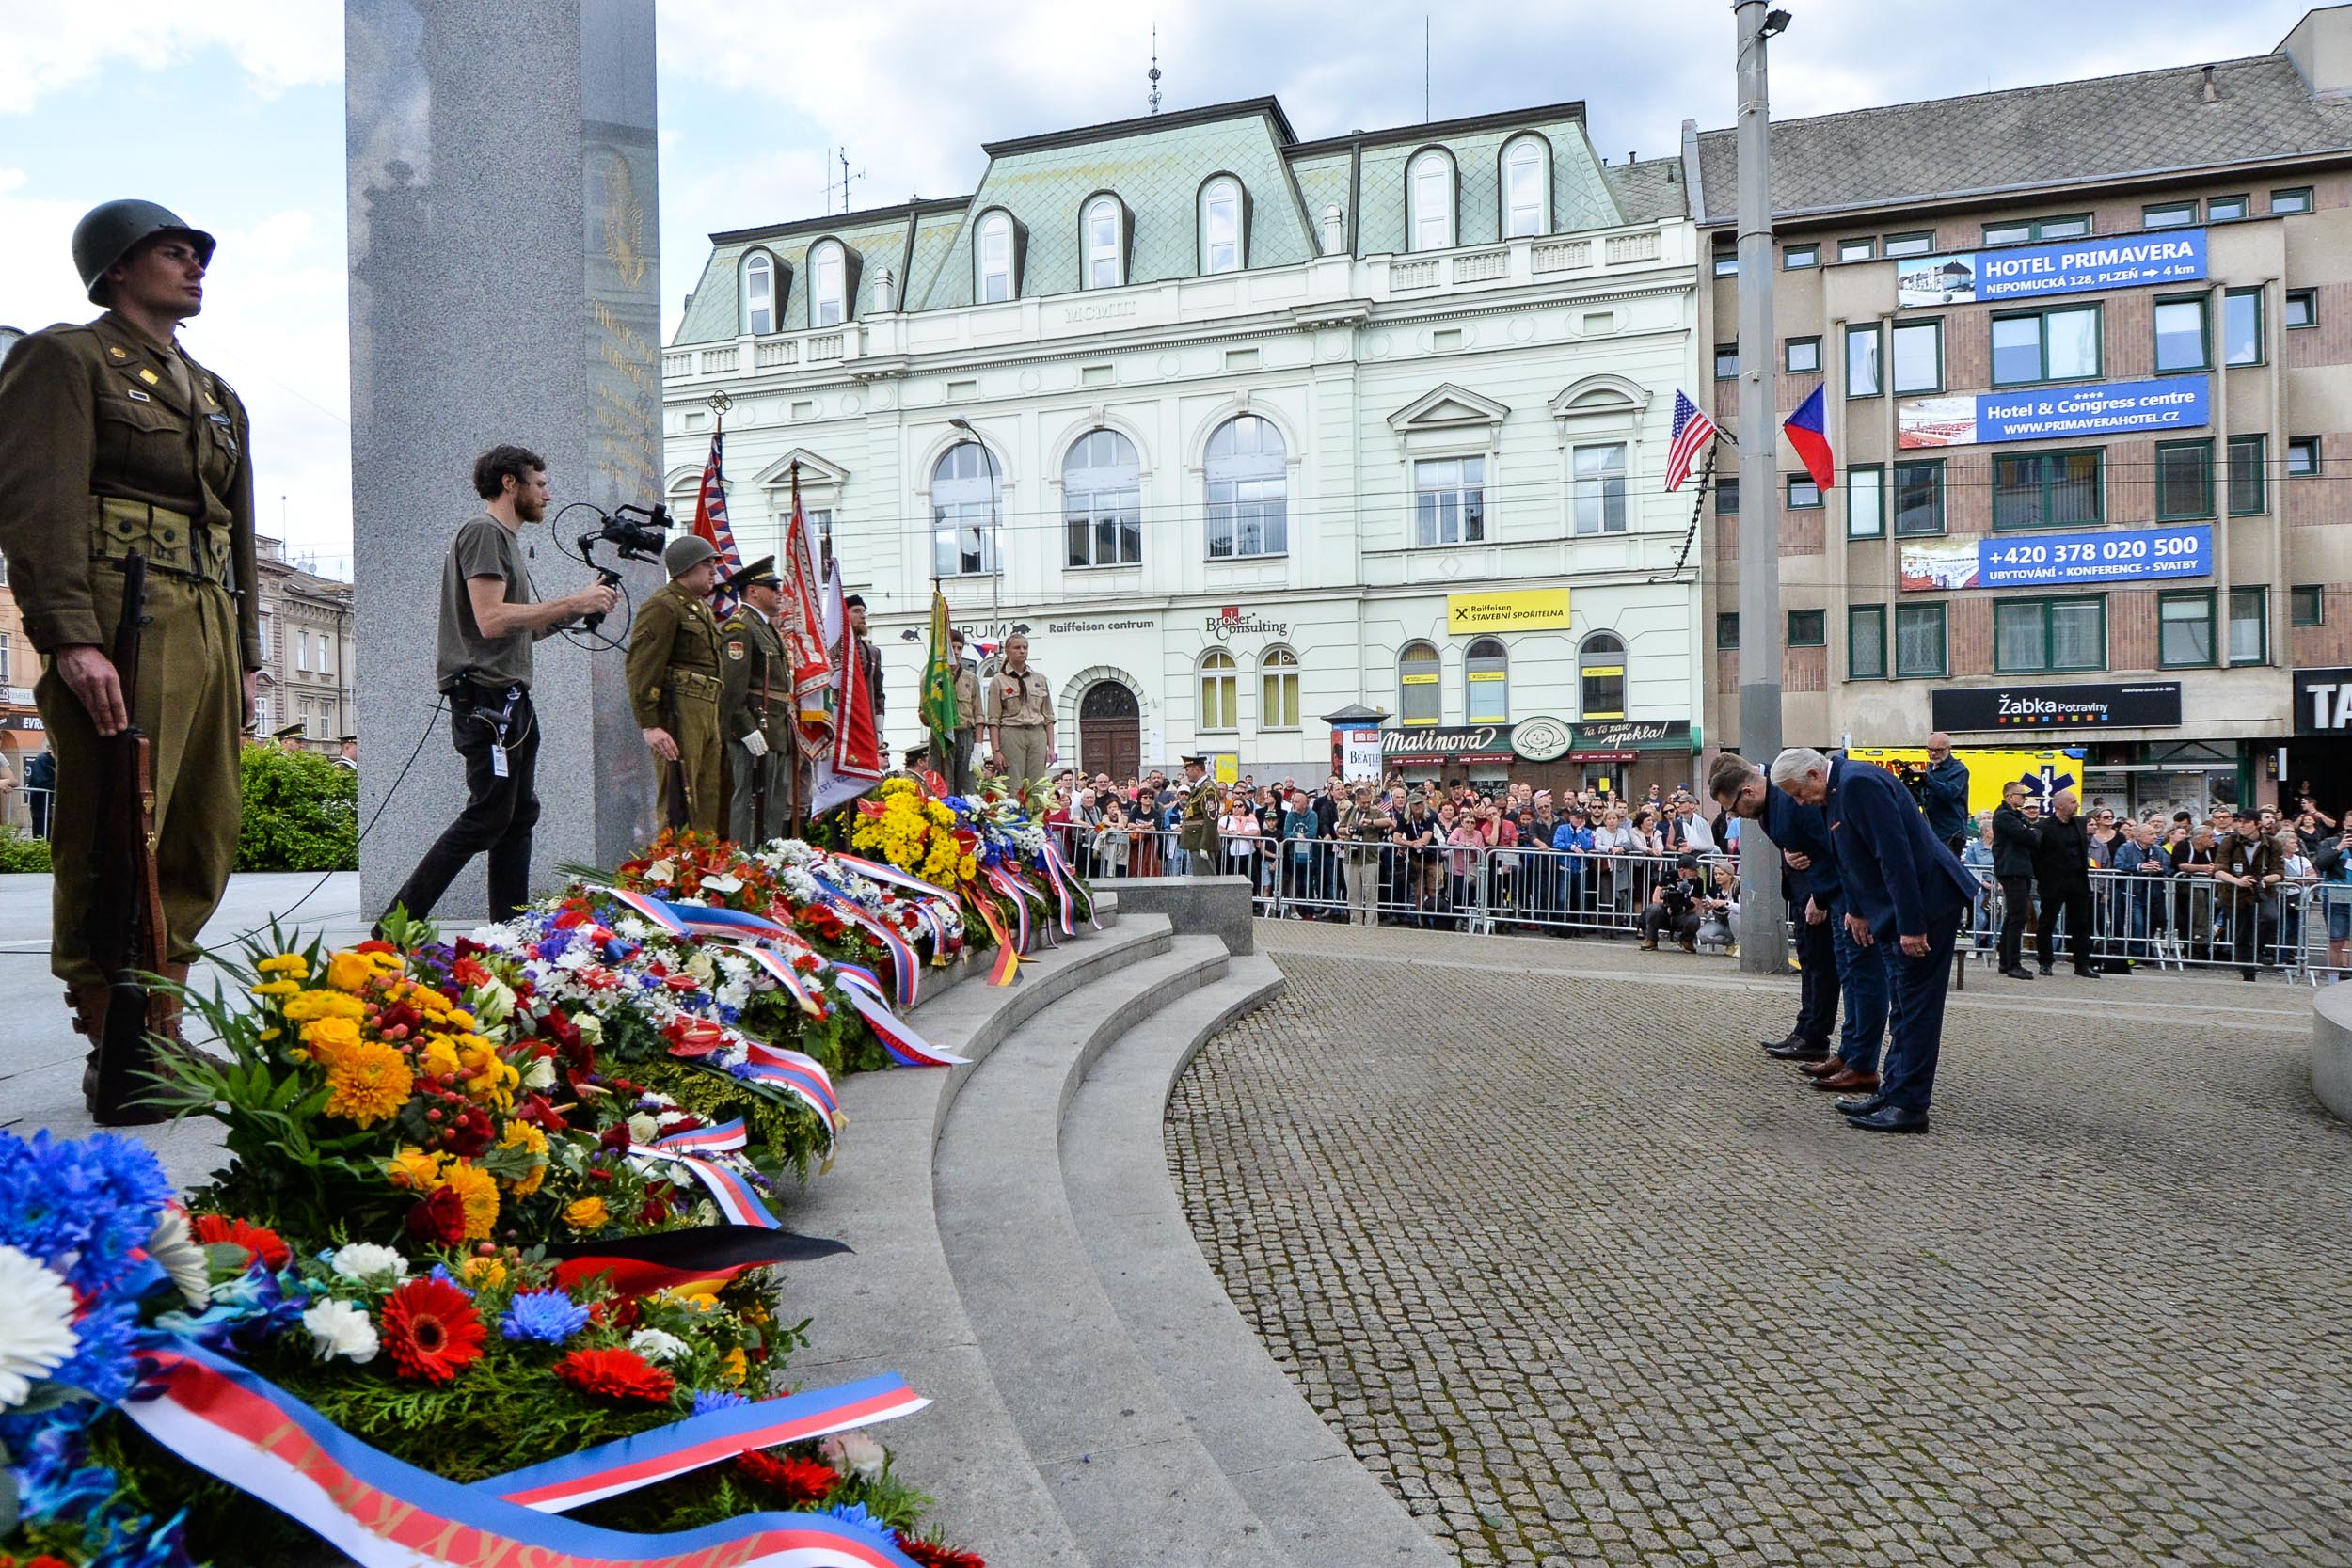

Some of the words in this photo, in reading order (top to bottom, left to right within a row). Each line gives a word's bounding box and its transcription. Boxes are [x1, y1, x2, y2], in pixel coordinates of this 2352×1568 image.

[1986, 256, 2056, 277] HOTEL
[2060, 241, 2194, 271] PRIMAVERA
[1986, 276, 2067, 294] NEPOMUCKÁ
[2070, 274, 2095, 286] 128,
[2098, 266, 2138, 284] PLZEŇ
[2162, 265, 2172, 277] 4
[2175, 264, 2195, 276] km
[1987, 402, 2033, 420] Hotel
[2038, 401, 2054, 415] &
[2058, 396, 2136, 415] Congress
[2139, 391, 2195, 408] centre
[2004, 411, 2180, 435] WWW.PRIMAVERAHOTEL.CZ
[1989, 546, 2047, 564] +420
[2054, 543, 2096, 562] 378
[2103, 540, 2147, 560] 020
[2153, 536, 2198, 556] 500
[1989, 566, 2057, 580] UBYTOVÁNÍ
[2066, 563, 2142, 577] KONFERENCE
[2153, 559, 2198, 572] SVATBY
[1471, 604, 1512, 612] Raiffeisen
[1471, 610, 1511, 621] STAVEBNÍ
[1513, 609, 1564, 619] SPOŘITELNA
[1049, 621, 1104, 633] Raiffeisen
[1108, 620, 1154, 630] centrum
[1205, 611, 1252, 632] Broker
[1216, 619, 1288, 641] Consulting
[1998, 694, 2057, 715] Žabka
[2058, 702, 2108, 714] Potraviny
